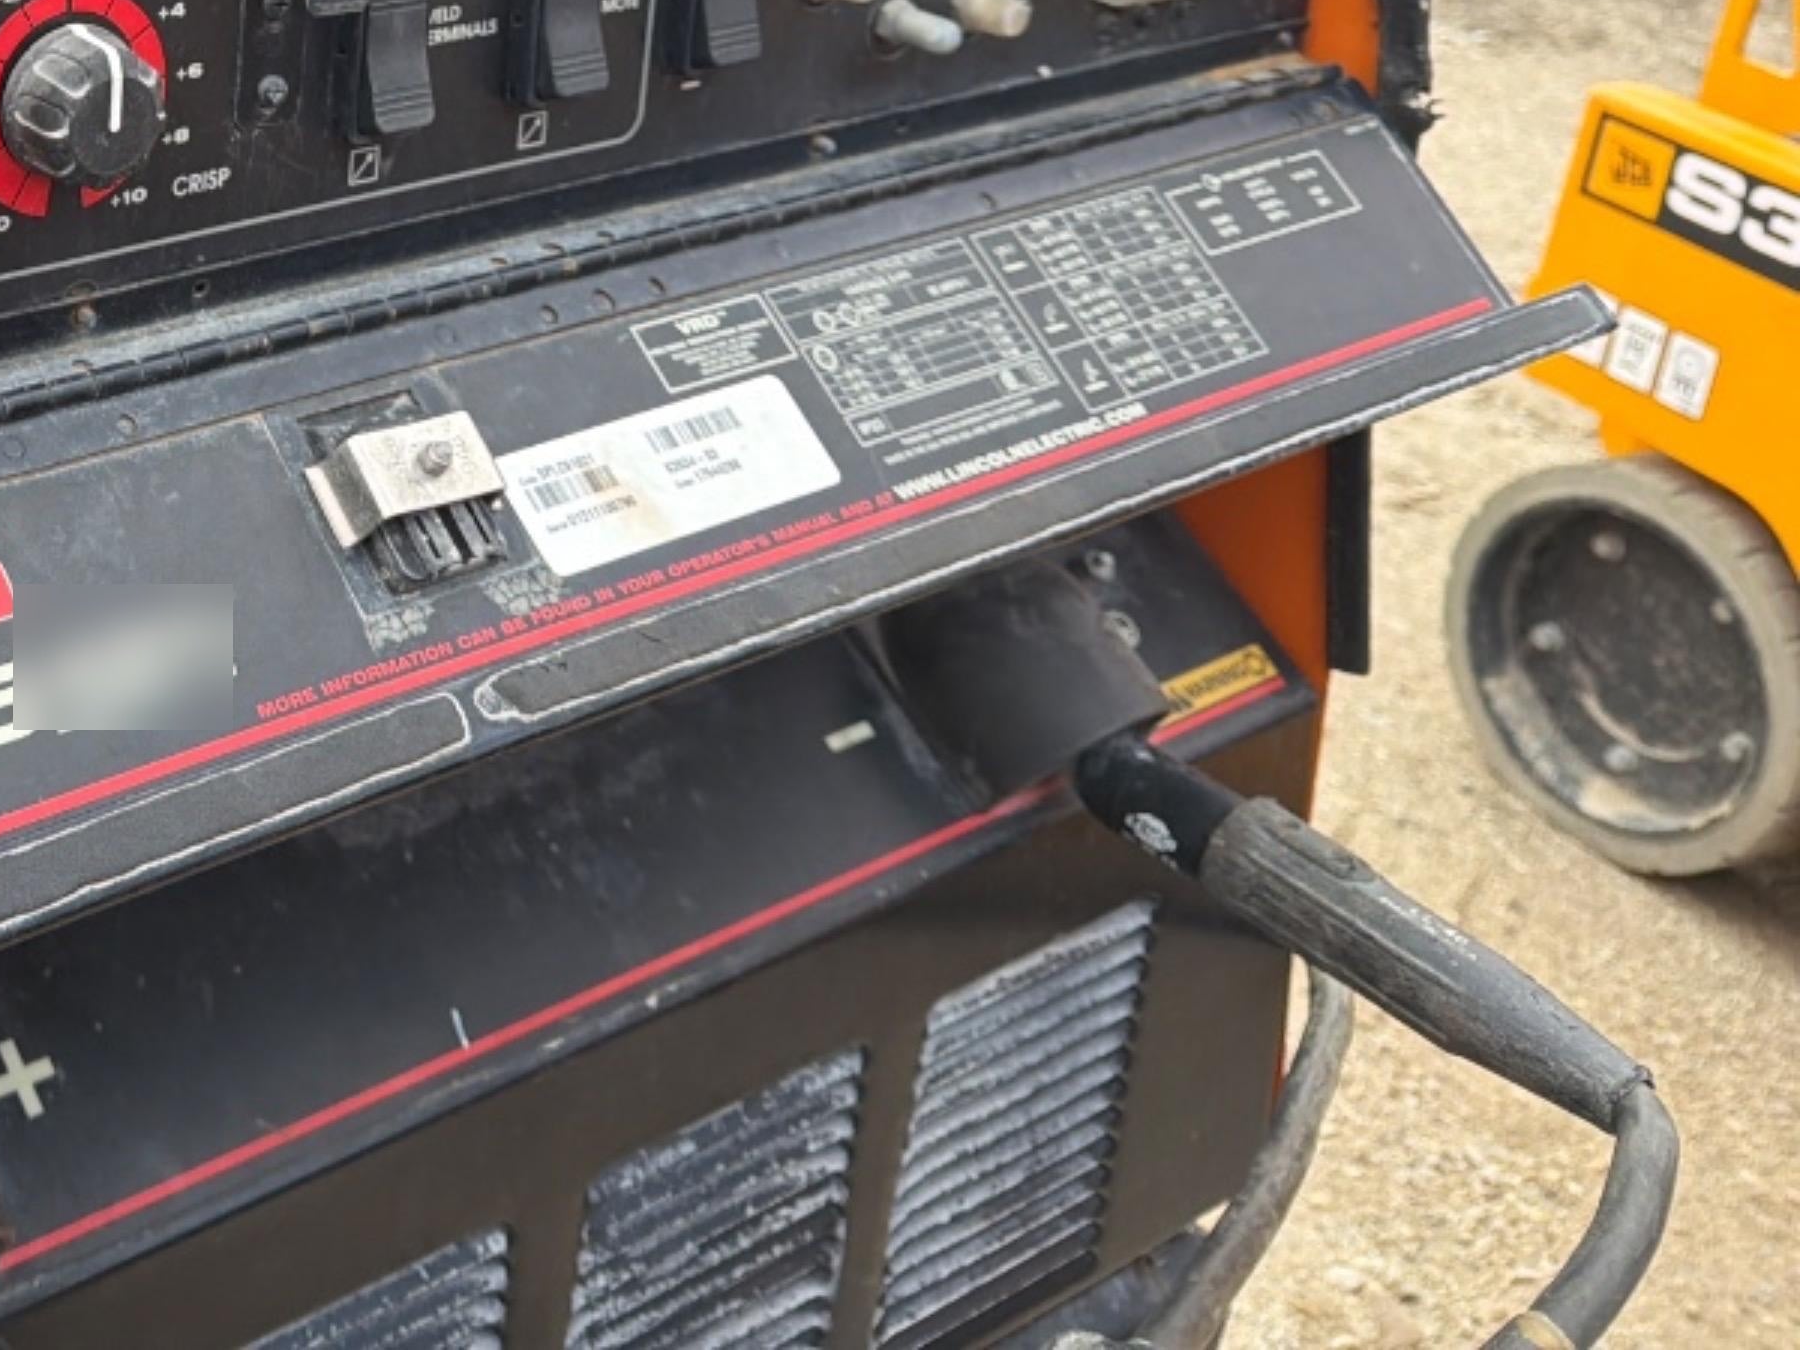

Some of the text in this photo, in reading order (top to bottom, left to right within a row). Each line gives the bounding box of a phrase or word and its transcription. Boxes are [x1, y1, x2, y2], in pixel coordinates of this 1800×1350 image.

[158, 2, 186, 20] +4
[428, 3, 463, 25] ELD
[428, 16, 499, 46] ERMINALS
[176, 63, 204, 80] +6
[161, 127, 190, 145] +8
[172, 168, 231, 198] CRISP
[110, 187, 148, 208] +10
[257, 686, 319, 720] MORE
[321, 640, 454, 698] INFORMATION
[456, 626, 497, 651] CAN
[501, 616, 527, 636] BE
[531, 596, 592, 628] FOUND
[595, 585, 616, 603] IN
[618, 570, 667, 597] YOUR
[667, 532, 773, 577] OPERATOR'S
[770, 513, 837, 547] MANUAL
[839, 502, 873, 522] AND
[892, 401, 1149, 501] WWW.LINCOLNELECTRIC.COM
